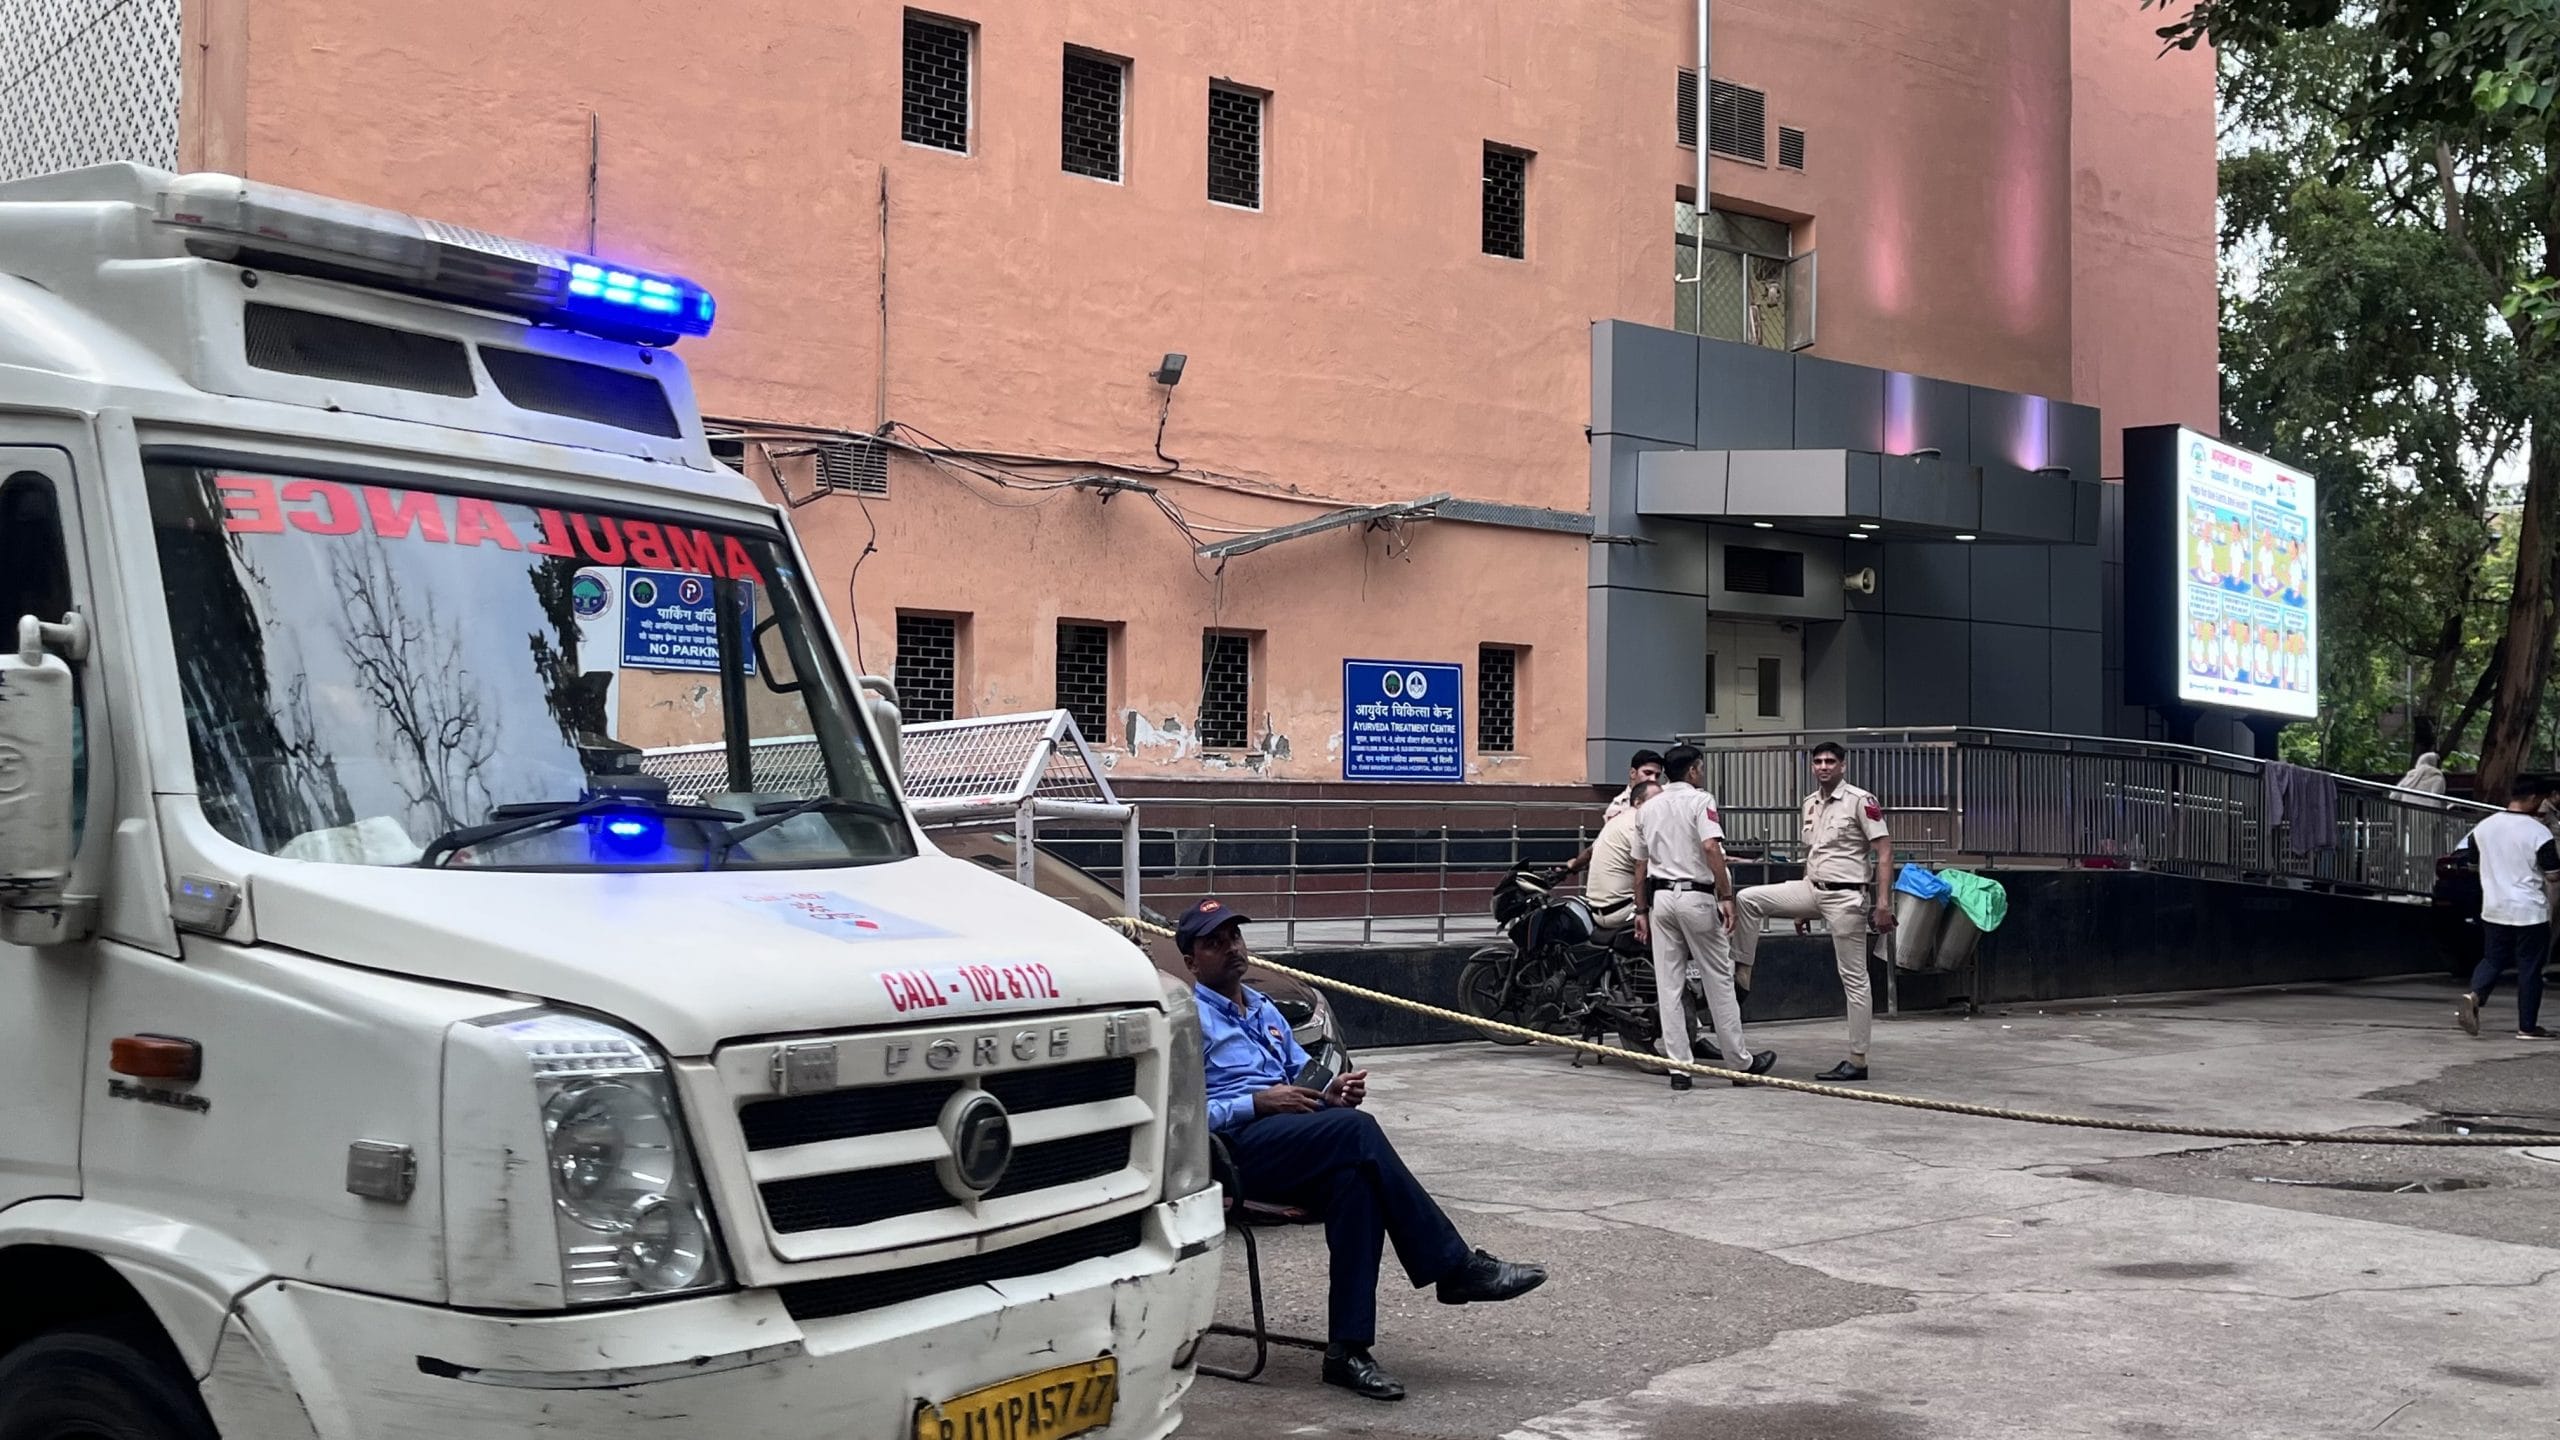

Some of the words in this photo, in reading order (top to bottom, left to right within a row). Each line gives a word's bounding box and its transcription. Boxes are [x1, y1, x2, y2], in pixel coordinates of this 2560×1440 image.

[657, 605, 691, 621] पार्किंग
[695, 608, 717, 623] वर्जि
[649, 643, 669, 655] NO
[672, 644, 720, 658] PARKIN
[1355, 701, 1389, 720] आयुर्वेद
[1391, 702, 1430, 718] चिकित्सा
[1432, 703, 1453, 720] केन्द्र
[1391, 722, 1429, 733] TREATMENT
[1430, 723, 1456, 734] CENTRE
[880, 971, 948, 1012] CALL
[884, 1027, 1071, 1076] FORCE
